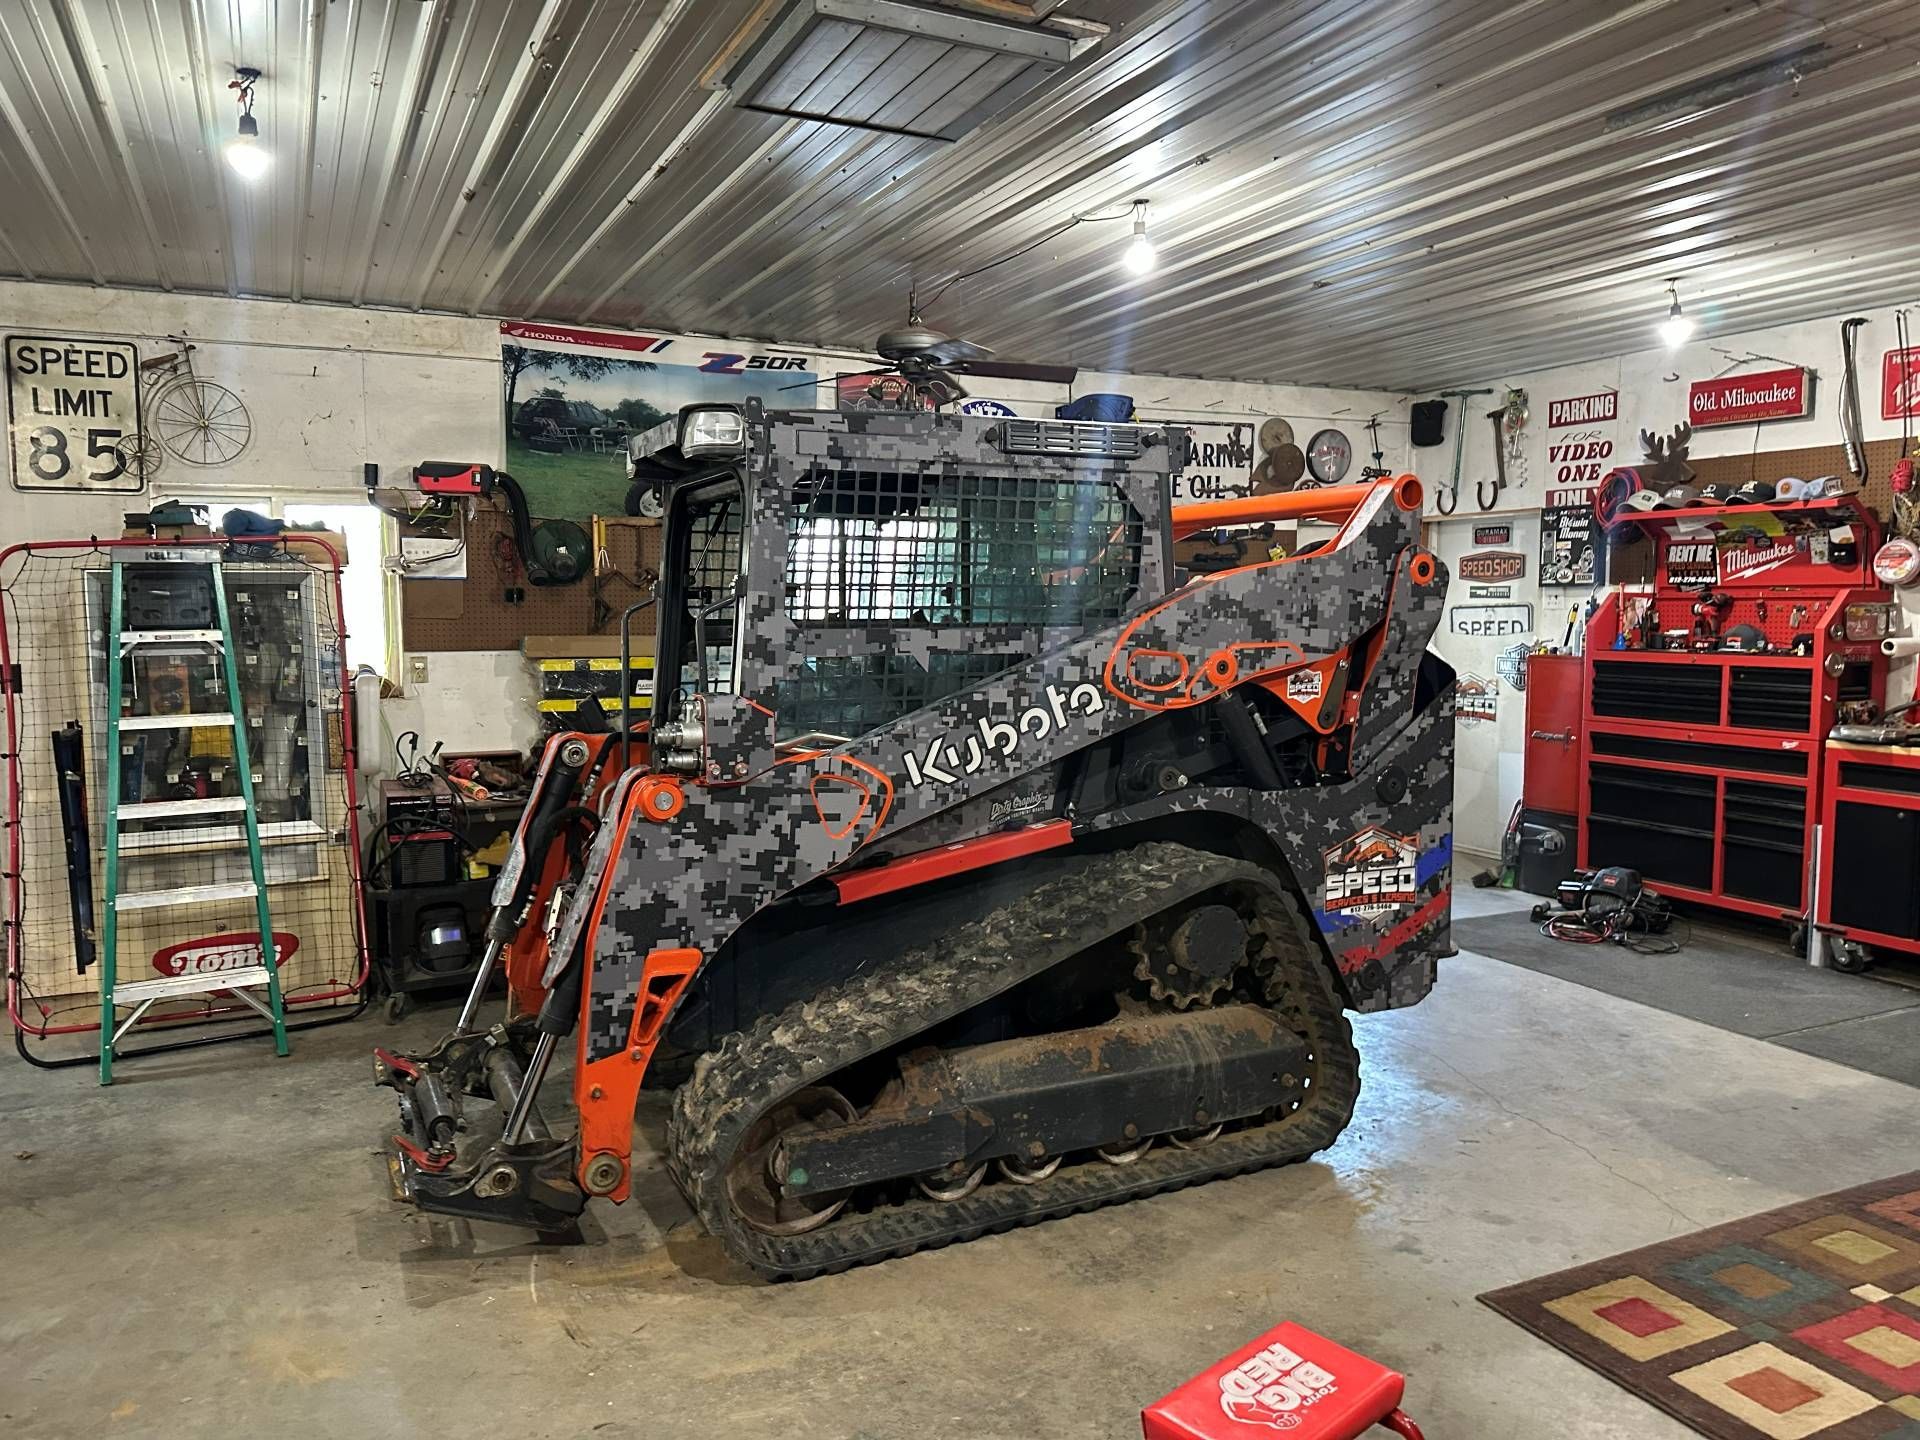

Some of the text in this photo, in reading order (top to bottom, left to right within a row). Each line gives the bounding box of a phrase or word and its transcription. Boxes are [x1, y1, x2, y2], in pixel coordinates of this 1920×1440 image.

[524, 330, 576, 343] HONDA
[16, 345, 128, 379] SPEED
[697, 352, 808, 374] Z 50R
[32, 386, 113, 418] LIMIT
[1693, 382, 1796, 412] Old Milwaukee
[1552, 394, 1615, 424] PARKING
[1560, 430, 1602, 443] FOR
[29, 425, 127, 482] 85
[1189, 442, 1246, 468] ARINE
[1549, 440, 1613, 463] VIDEO
[1557, 463, 1602, 483] ONE
[1189, 474, 1226, 498] OIL
[1559, 528, 1590, 541] Money
[1668, 544, 1714, 562] RENT ME
[1722, 543, 1794, 573] Milwaukee
[1462, 559, 1521, 576] SPEED SHOP
[1458, 620, 1523, 635] SPEED
[903, 683, 1104, 787] Kubota
[991, 800, 1011, 818] Dirty
[1326, 867, 1416, 900] SPEED
[1326, 895, 1369, 910] SERVICES
[1380, 892, 1415, 901] LEASING
[1219, 1342, 1304, 1397] RED
[1254, 1361, 1336, 1411] BIG
[1302, 1384, 1338, 1407] Torin
